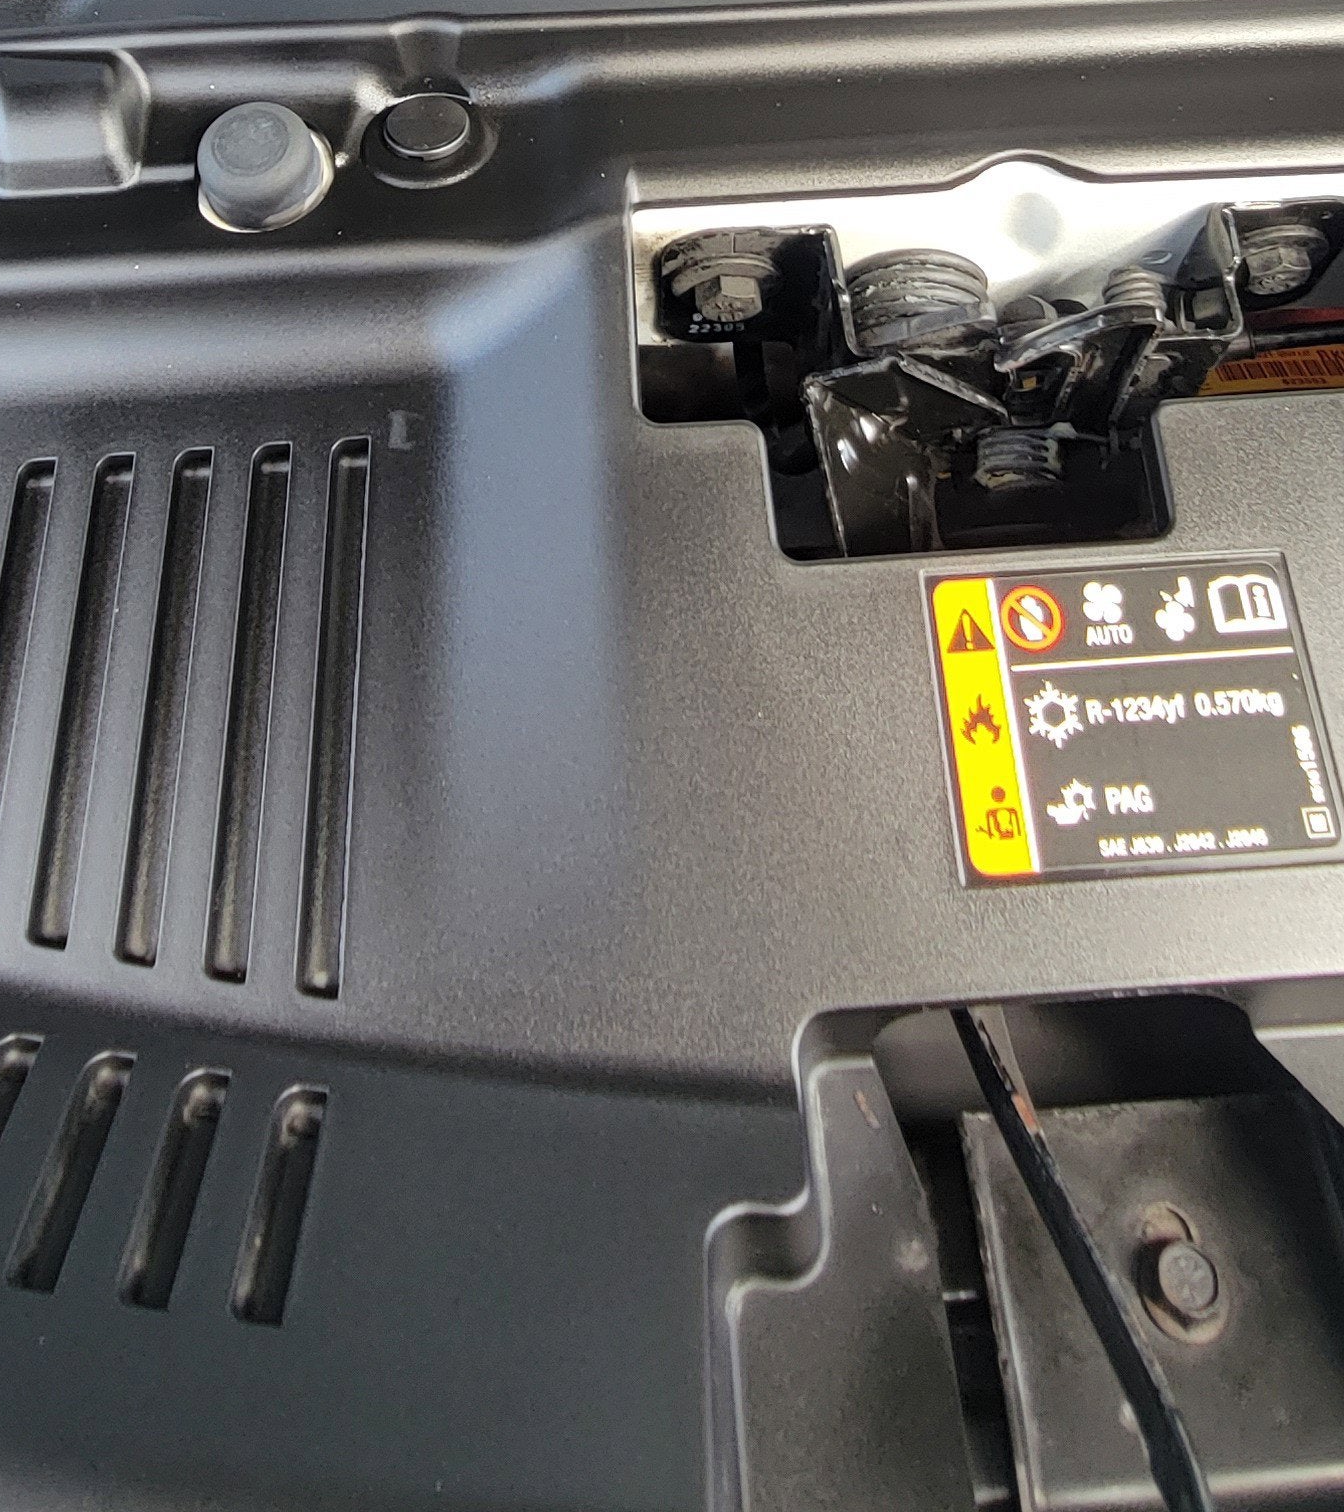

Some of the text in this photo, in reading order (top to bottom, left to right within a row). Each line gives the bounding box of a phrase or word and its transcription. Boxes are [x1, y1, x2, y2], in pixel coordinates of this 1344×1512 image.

[1085, 624, 1133, 646] AUTO
[1085, 688, 1285, 724] R-1234yf 0.570kg
[1104, 784, 1154, 815] PAG
